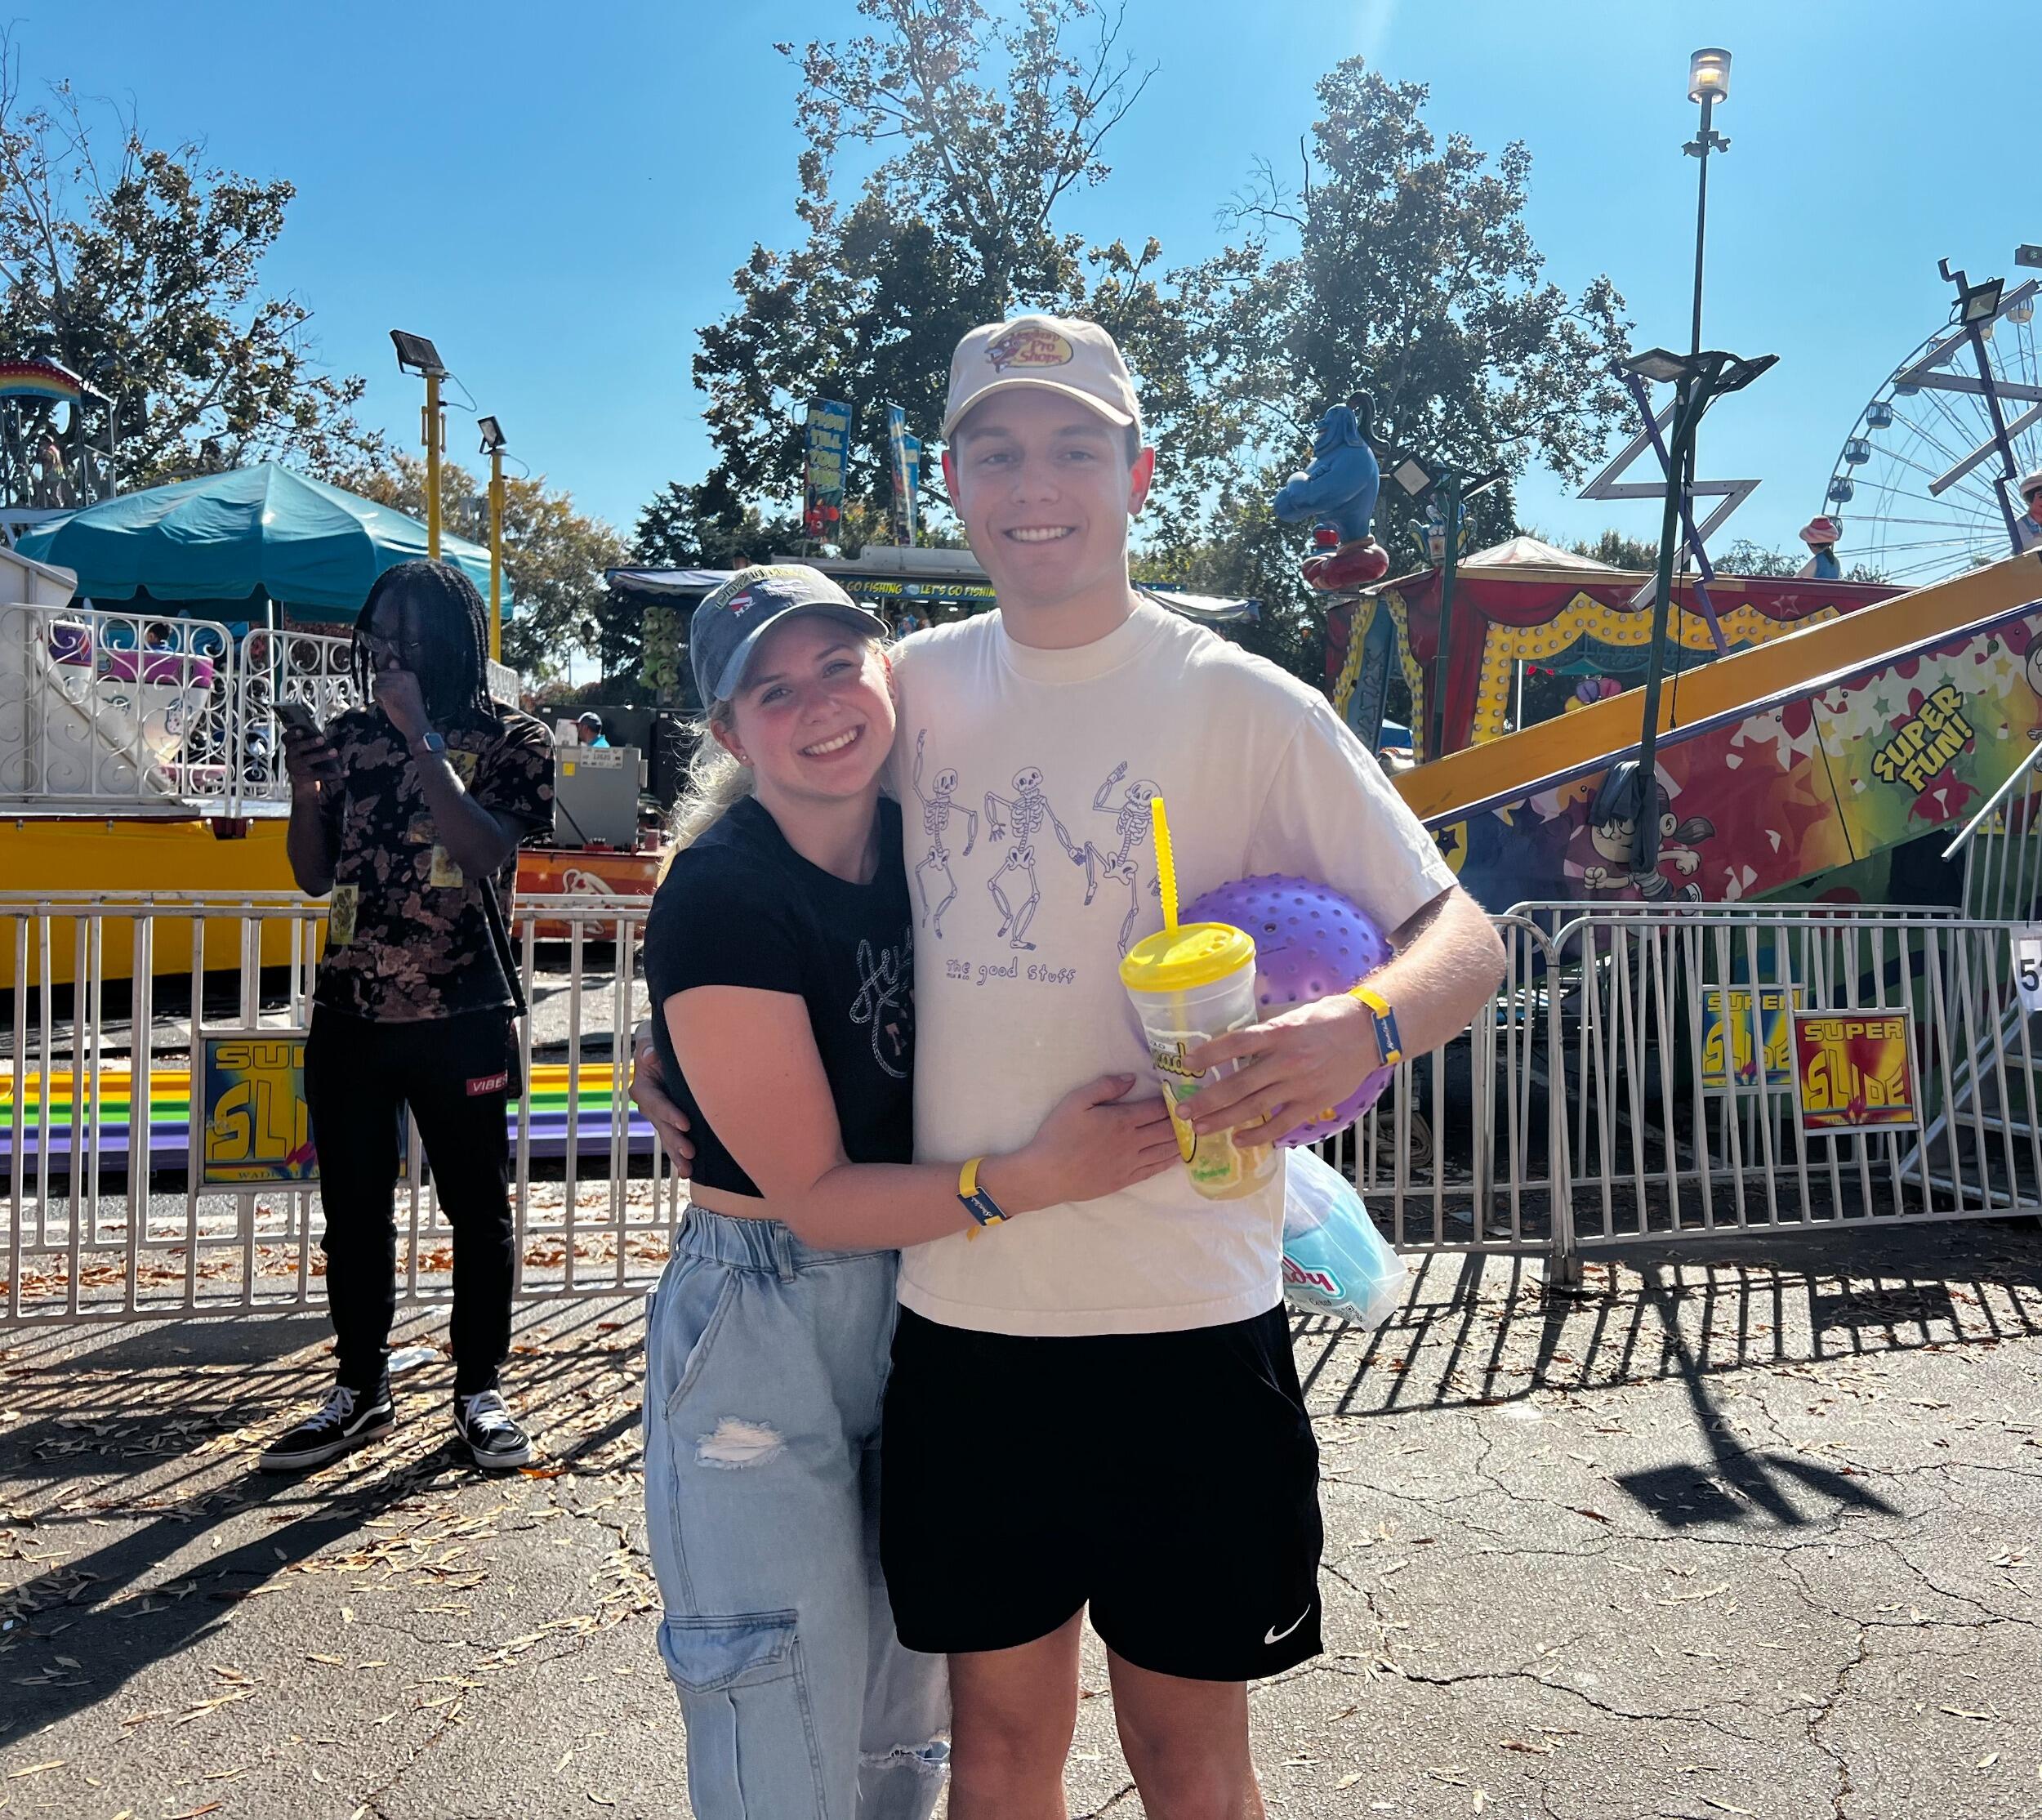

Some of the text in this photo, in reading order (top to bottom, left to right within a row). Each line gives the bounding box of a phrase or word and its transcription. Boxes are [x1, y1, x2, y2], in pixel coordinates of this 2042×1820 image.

[1020, 350, 1063, 364] Shops
[1031, 340, 1055, 358] Pro
[809, 429, 843, 449] TILL
[809, 448, 841, 469] YOU
[846, 581, 863, 592] GO
[863, 581, 903, 595] FISHING
[920, 583, 947, 596] LET'S
[947, 584, 963, 597] GO
[1873, 685, 1964, 782] SUPER
[1900, 712, 1974, 793] FUN!
[946, 959, 971, 975] The
[977, 956, 1018, 986] good
[2020, 958, 2042, 993] 5
[1804, 1022, 1904, 1042] SUPER
[1808, 1048, 1906, 1111] SLIDE
